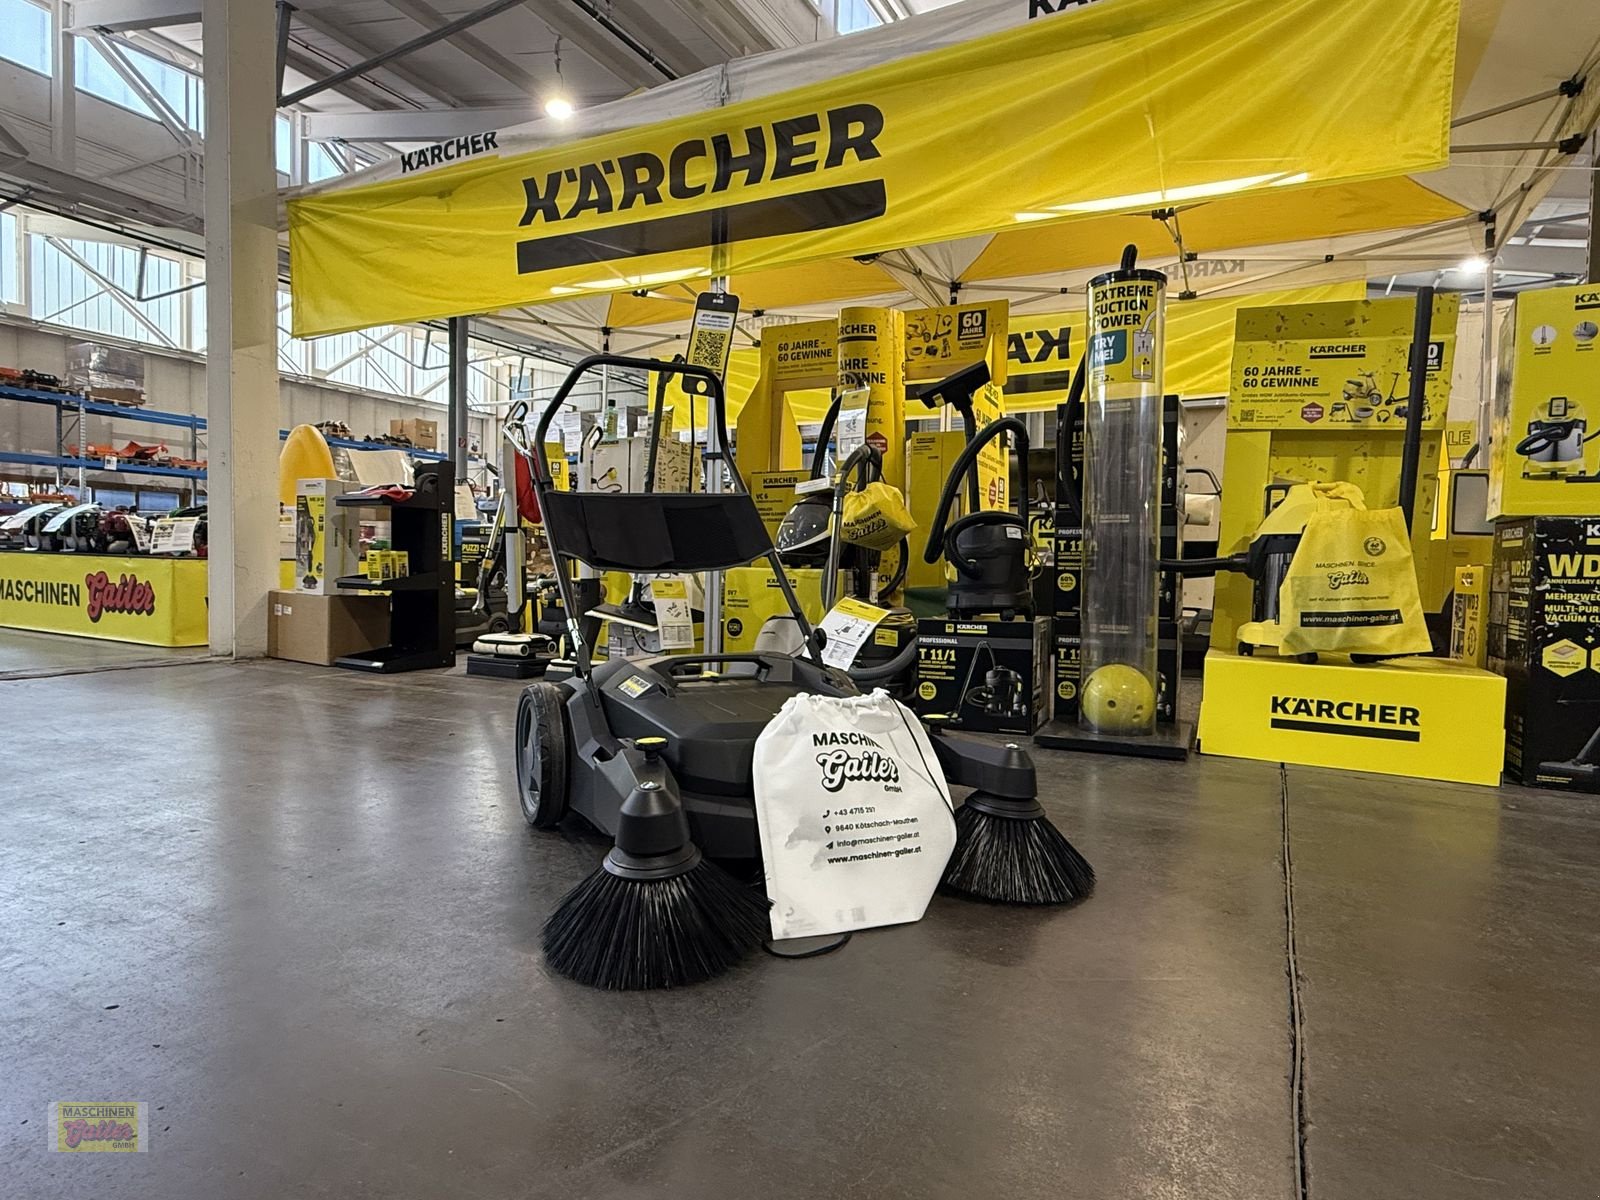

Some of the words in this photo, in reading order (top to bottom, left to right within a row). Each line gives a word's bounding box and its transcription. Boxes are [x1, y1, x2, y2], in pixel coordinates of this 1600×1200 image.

[401, 131, 499, 173] KÄRCHER
[518, 103, 884, 228] KÄRCHER
[1094, 285, 1154, 303] EXTREME
[1094, 299, 1148, 317] SUCTION
[962, 312, 982, 328] 60
[1095, 313, 1141, 330] POWER
[961, 326, 983, 336] JAHRE
[777, 342, 789, 352] 60
[791, 339, 819, 352] JAHRE
[1094, 335, 1116, 348] TRY
[777, 352, 789, 362] 60
[790, 348, 833, 361] GEWINNE
[1095, 349, 1114, 362] ME!
[1310, 344, 1366, 354] KÄRCHER
[1244, 366, 1259, 377] 60
[1262, 365, 1302, 377] JAHRE
[1243, 378, 1259, 388] 60
[1261, 377, 1319, 388] GEWINNE
[462, 543, 480, 552] PUZZI
[85, 571, 155, 623] Gailer
[1303, 612, 1399, 624] www.maschinen-gailer.at
[1544, 613, 1587, 623] VACUUM
[919, 637, 958, 645] PROFESSIONAL
[919, 648, 927, 660] T
[930, 648, 956, 661] 11/1
[1271, 696, 1421, 727] KÄRCHER
[815, 748, 899, 793] Gailer
[834, 808, 848, 816] +43
[849, 806, 865, 815] 4715
[835, 823, 854, 832] 9640
[836, 831, 920, 847] info@maschinen-gailer.at
[827, 845, 922, 865] www.maschinen-gailer.at
